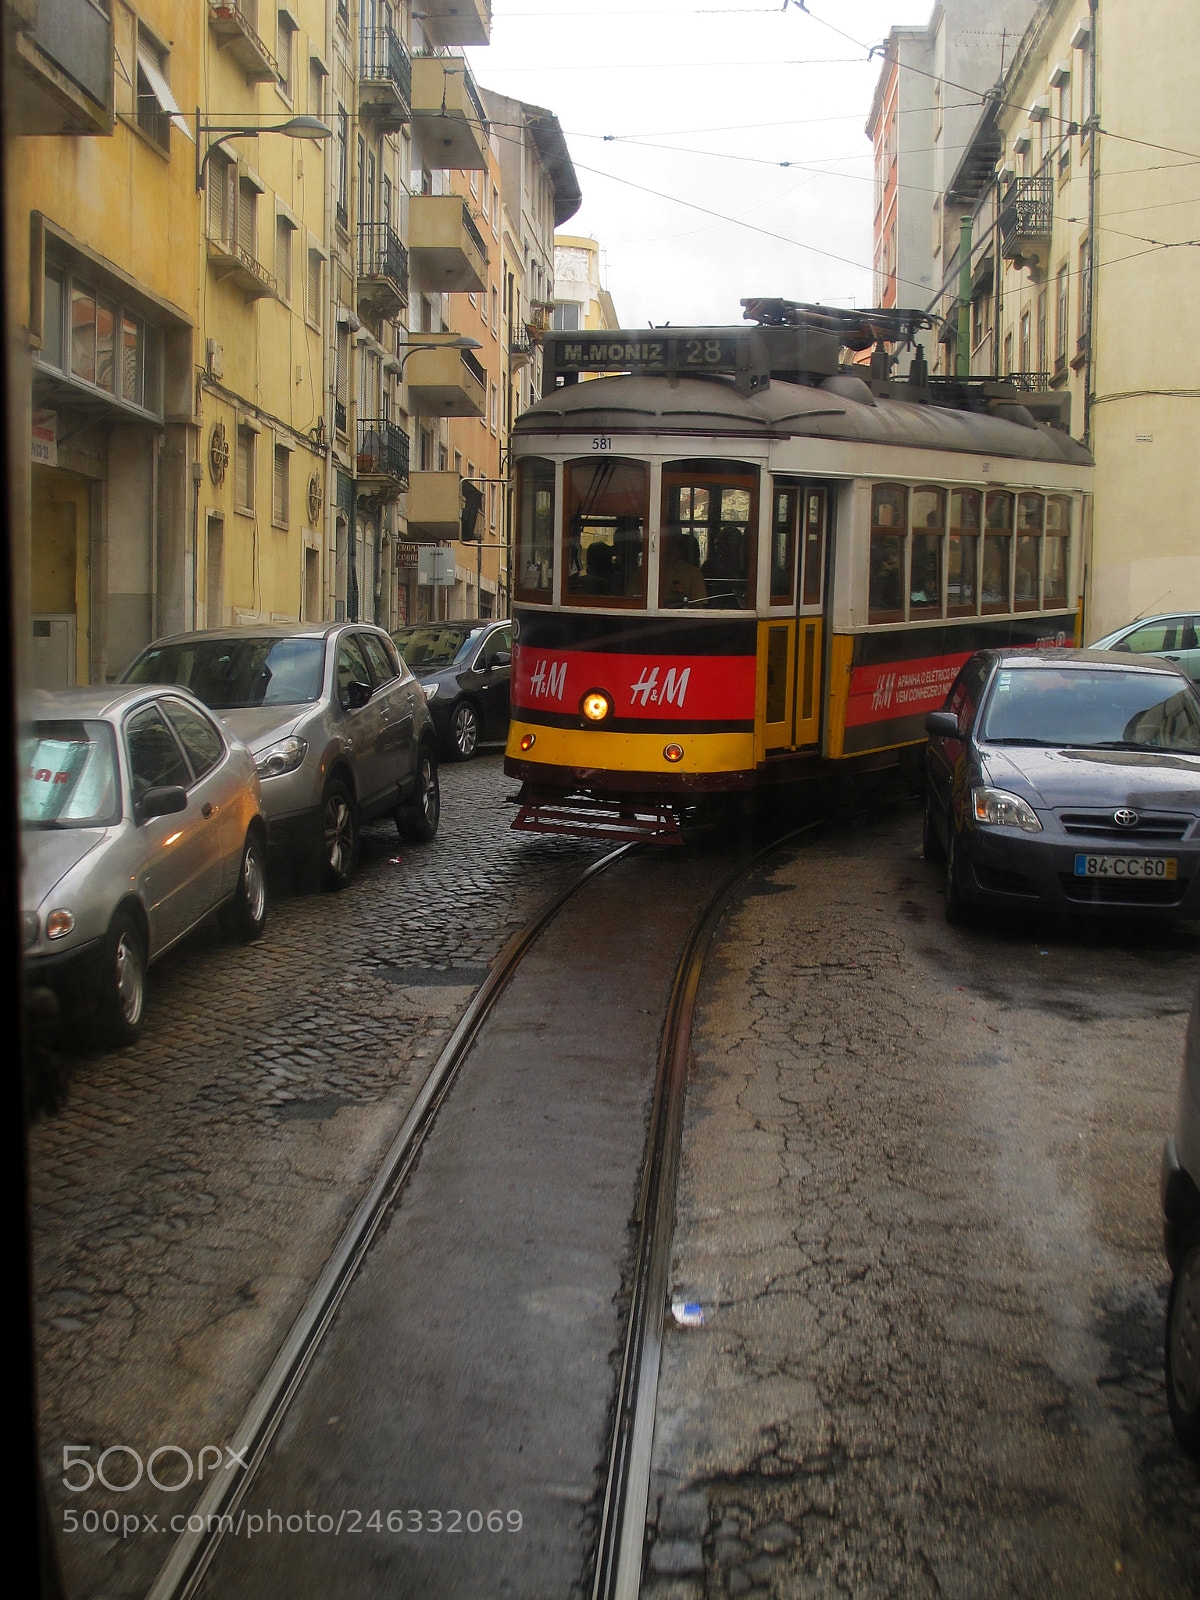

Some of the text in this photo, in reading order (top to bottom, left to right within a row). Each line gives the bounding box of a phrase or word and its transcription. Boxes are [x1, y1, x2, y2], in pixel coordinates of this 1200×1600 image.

[564, 340, 722, 363] M.MONIZ 28
[592, 438, 612, 450] 581
[530, 660, 568, 701] H&M
[630, 667, 692, 708] H&M
[871, 672, 896, 711] H&M
[897, 673, 920, 688] APANHA
[921, 672, 926, 684] O
[896, 690, 908, 703] VEM
[909, 686, 937, 701] CONHECER
